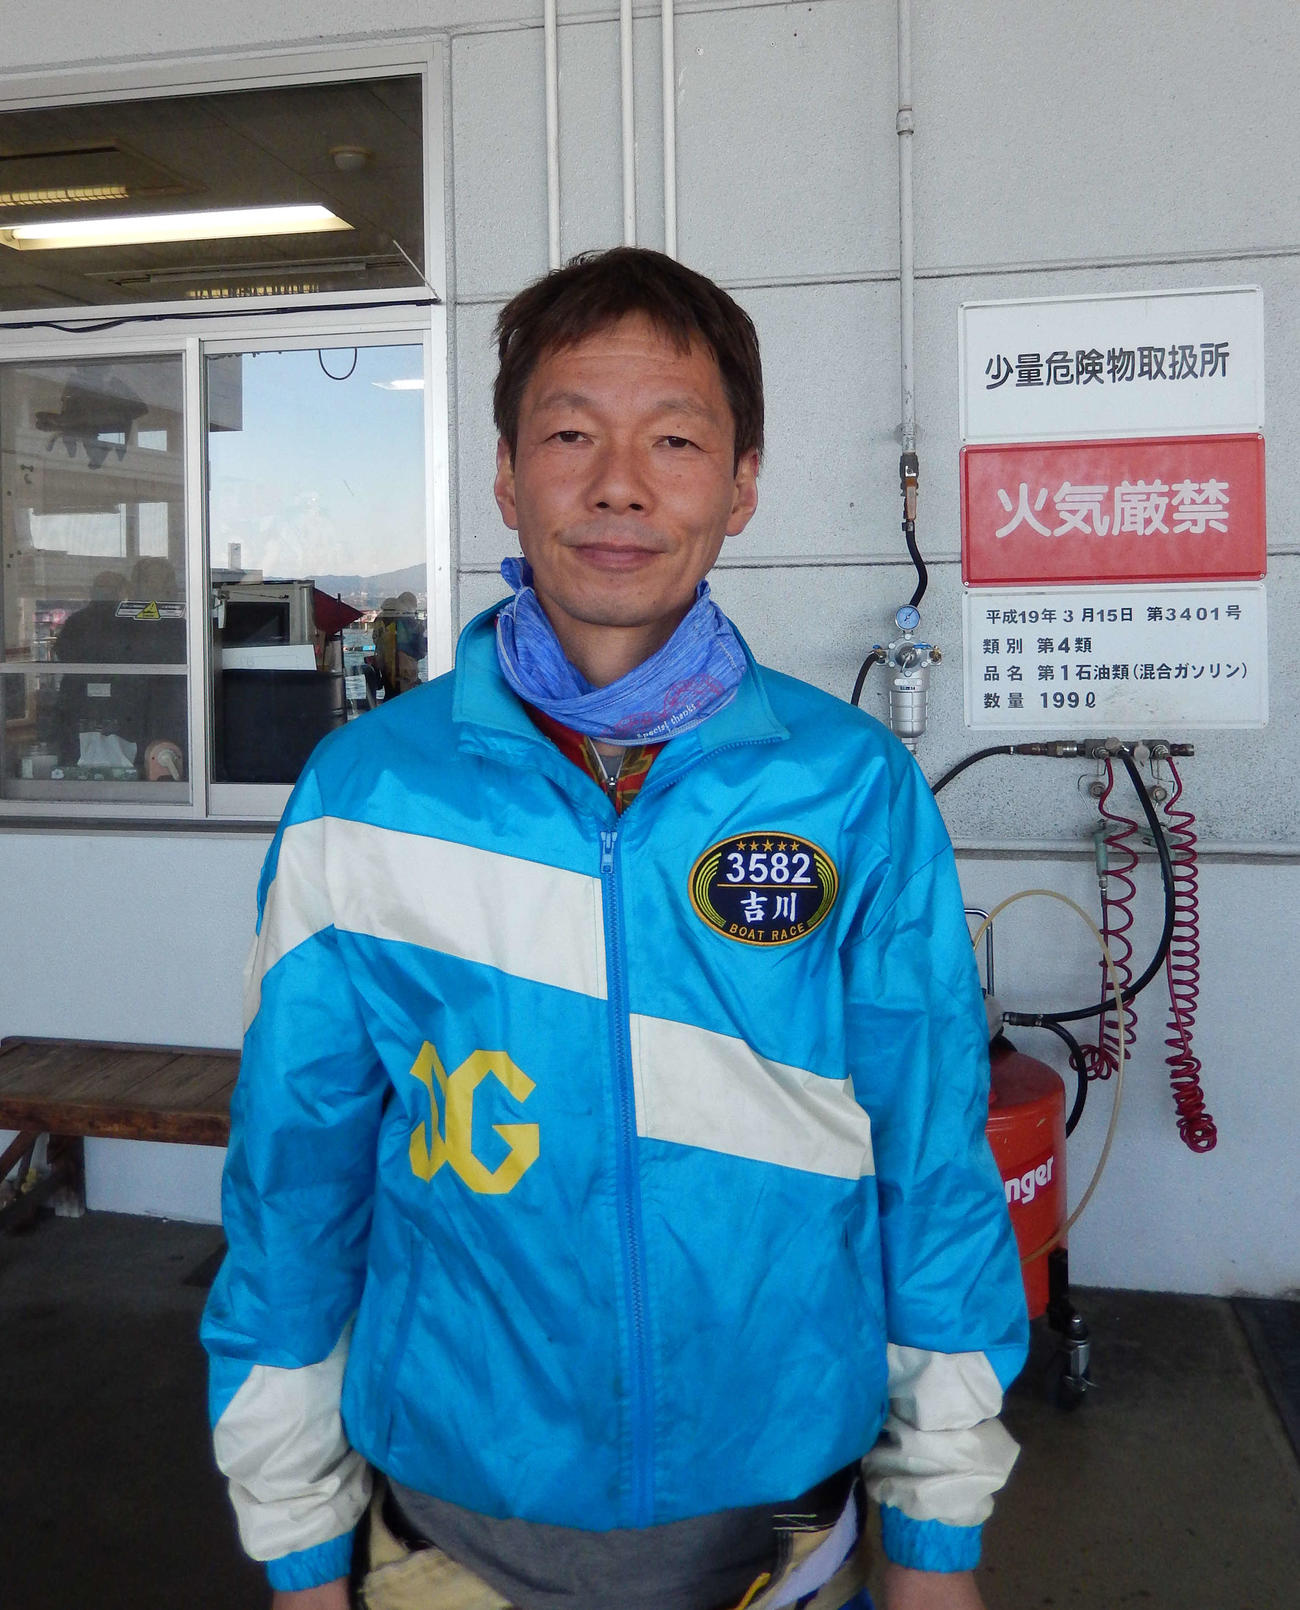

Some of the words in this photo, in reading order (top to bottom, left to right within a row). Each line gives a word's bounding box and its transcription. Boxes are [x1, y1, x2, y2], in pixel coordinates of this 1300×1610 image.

[985, 341, 1231, 390] 少量危険物取扱所
[995, 478, 1230, 539] 火気厳禁
[1146, 604, 1243, 622] 第3401号
[982, 638, 1024, 655] 類別
[1036, 636, 1093, 654] 第4類
[983, 665, 1024, 682] 品名
[983, 692, 1025, 710] 数量
[726, 852, 812, 884] 3582
[739, 890, 799, 923] 吉川
[728, 923, 766, 941] BOAT
[772, 922, 806, 942] RACE
